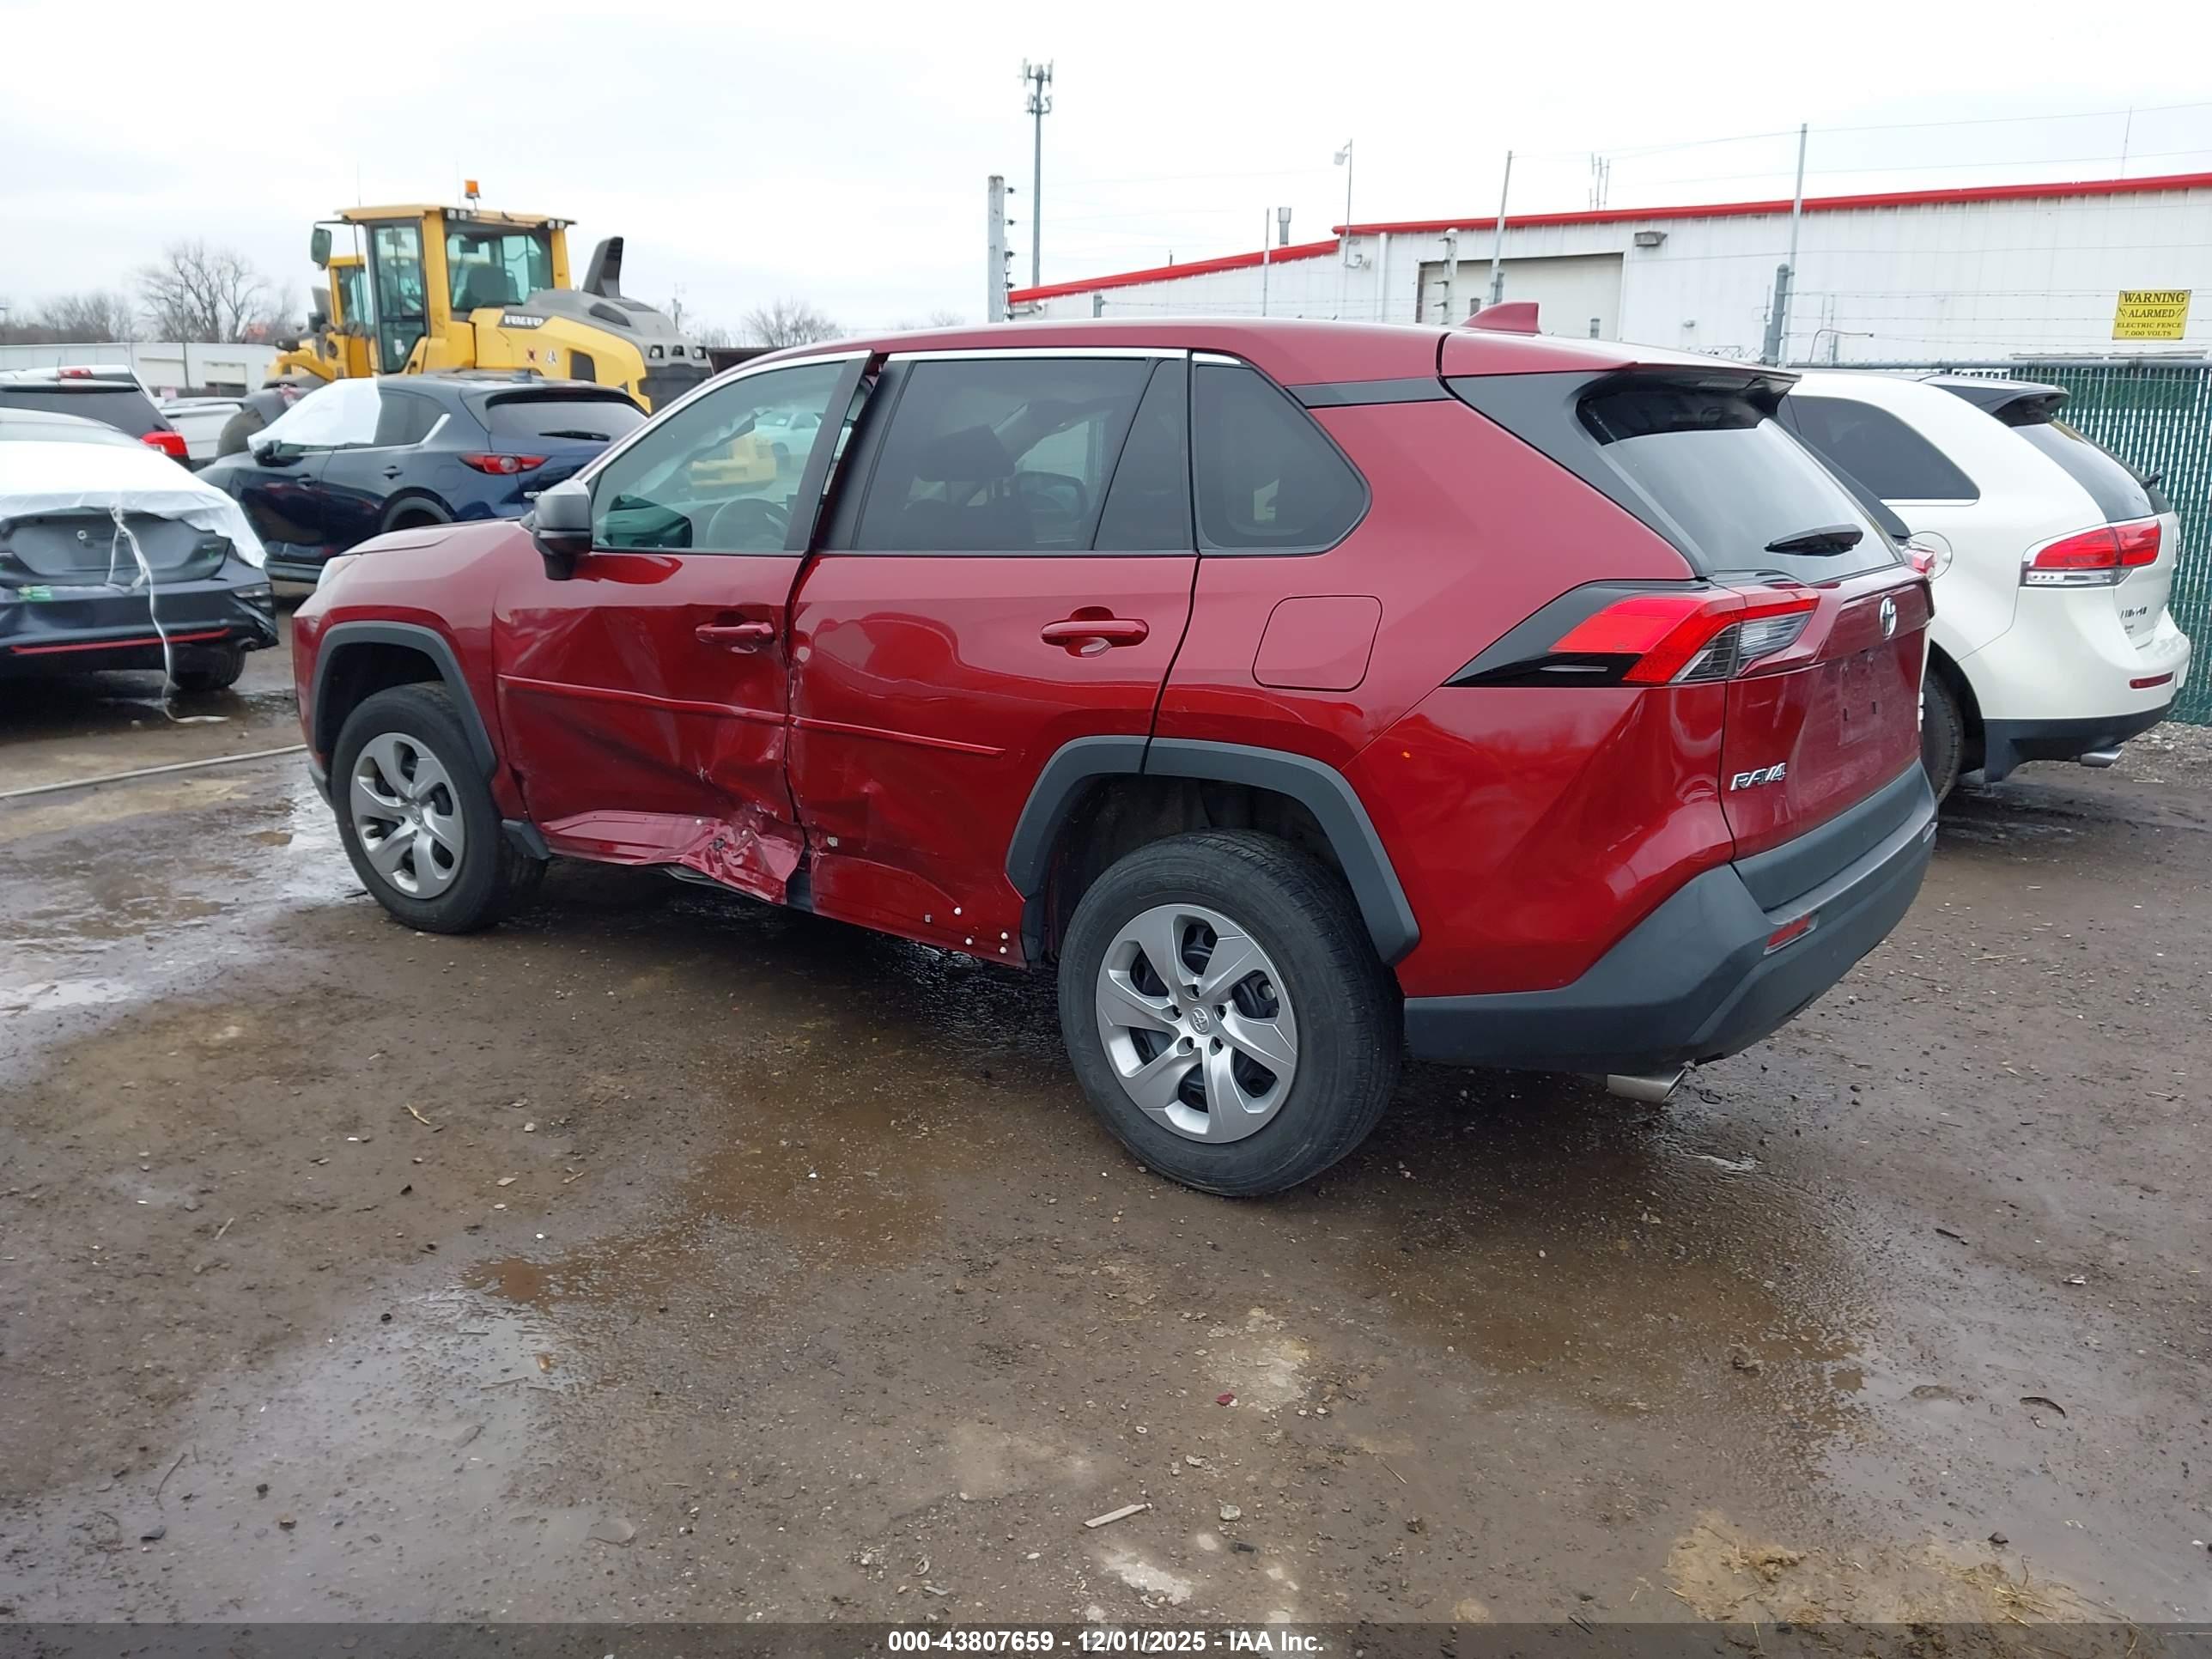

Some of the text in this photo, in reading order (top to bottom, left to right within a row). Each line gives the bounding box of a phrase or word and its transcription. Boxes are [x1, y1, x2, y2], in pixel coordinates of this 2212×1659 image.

[2124, 293, 2185, 303] WARNING
[2128, 309, 2175, 318] ALARMED
[1730, 763, 1787, 791] RAV4
